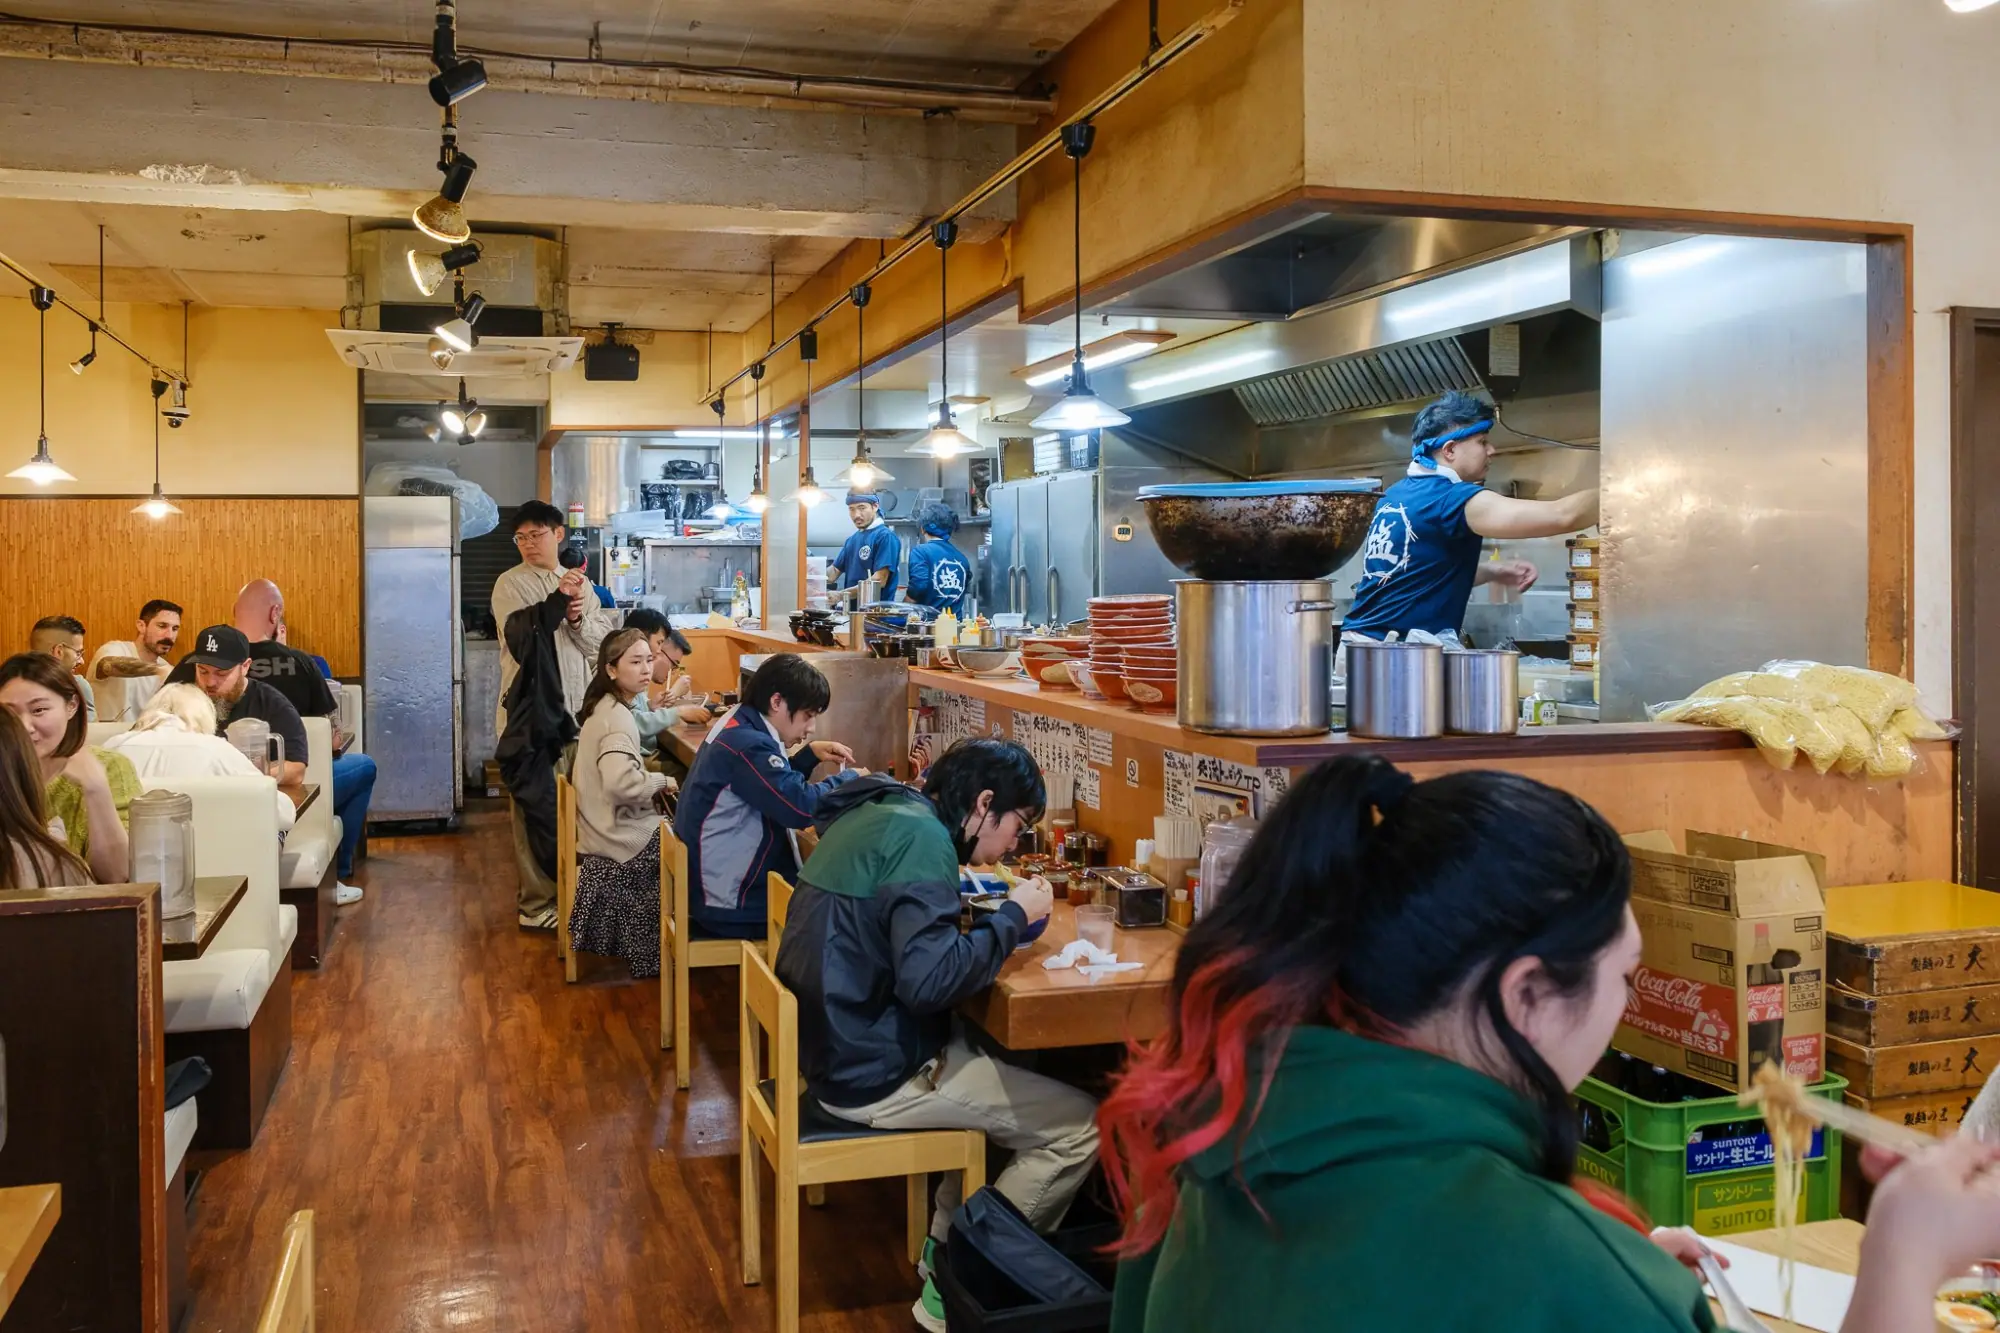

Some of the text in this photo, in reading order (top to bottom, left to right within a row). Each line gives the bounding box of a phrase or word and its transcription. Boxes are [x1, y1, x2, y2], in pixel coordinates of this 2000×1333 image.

[939, 566, 963, 593] 塩
[206, 634, 219, 652] LA
[249, 656, 296, 679] SH
[1712, 1136, 1758, 1150] SUNTORY
[1577, 1155, 1617, 1187] TORY
